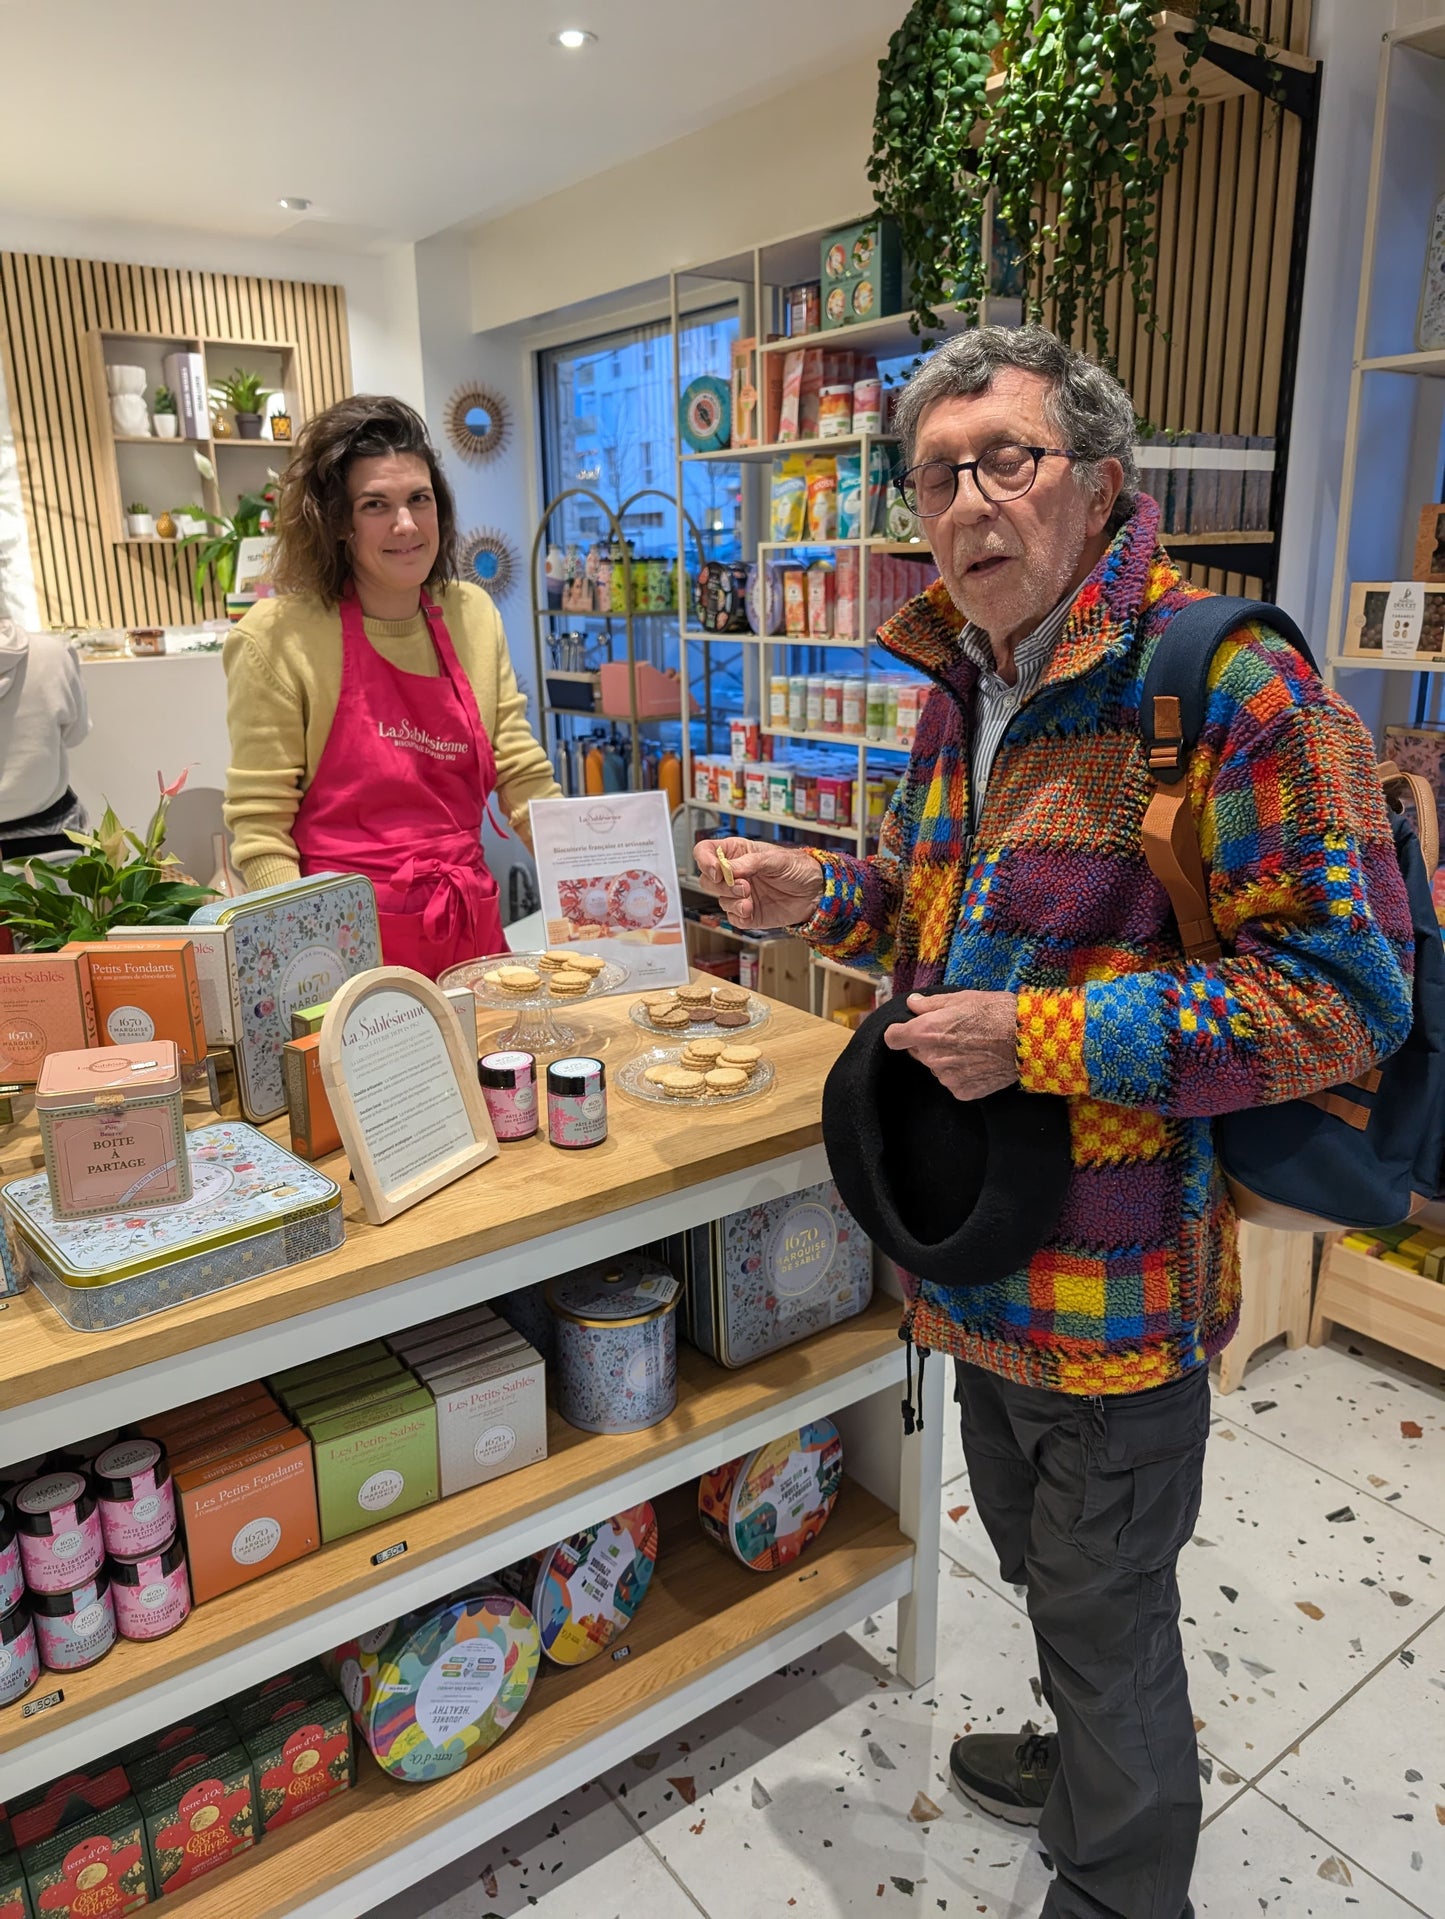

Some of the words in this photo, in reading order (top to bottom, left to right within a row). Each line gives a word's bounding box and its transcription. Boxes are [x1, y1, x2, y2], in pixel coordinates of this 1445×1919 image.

[378, 721, 396, 737] La
[396, 718, 468, 753] Sablésienne
[92, 963, 122, 974] Petits
[124, 962, 175, 974] Fondants
[0, 972, 21, 984] tits
[297, 971, 331, 995] 1670
[119, 1019, 142, 1028] 1670
[8, 1031, 33, 1041] 1670
[342, 1032, 358, 1047] La
[93, 1136, 136, 1151] BOITE
[111, 1148, 120, 1159] À
[87, 1158, 146, 1175] PARTAGE
[785, 1227, 818, 1251] 1670
[782, 1263, 793, 1273] DE
[794, 1251, 821, 1268] SABLE
[448, 1400, 469, 1413] Les
[470, 1389, 501, 1405] Petits
[502, 1376, 536, 1394] Sablés
[330, 1448, 351, 1460] Les
[354, 1435, 387, 1452] Petits
[390, 1421, 426, 1438] Sablés
[485, 1434, 506, 1448] 1670
[195, 1498, 216, 1512] Les
[218, 1484, 250, 1502] Petits
[253, 1459, 304, 1487] Fondants
[370, 1479, 393, 1493] 1670
[239, 1533, 275, 1552] MARQUISE
[245, 1528, 269, 1544] 1670
[65, 1640, 82, 1649] PÂTE
[286, 1743, 303, 1755] terre
[433, 1752, 453, 1761] terre
[183, 1800, 201, 1813] terre
[66, 1857, 87, 1871] terre
[88, 1844, 109, 1859] d'Oc
